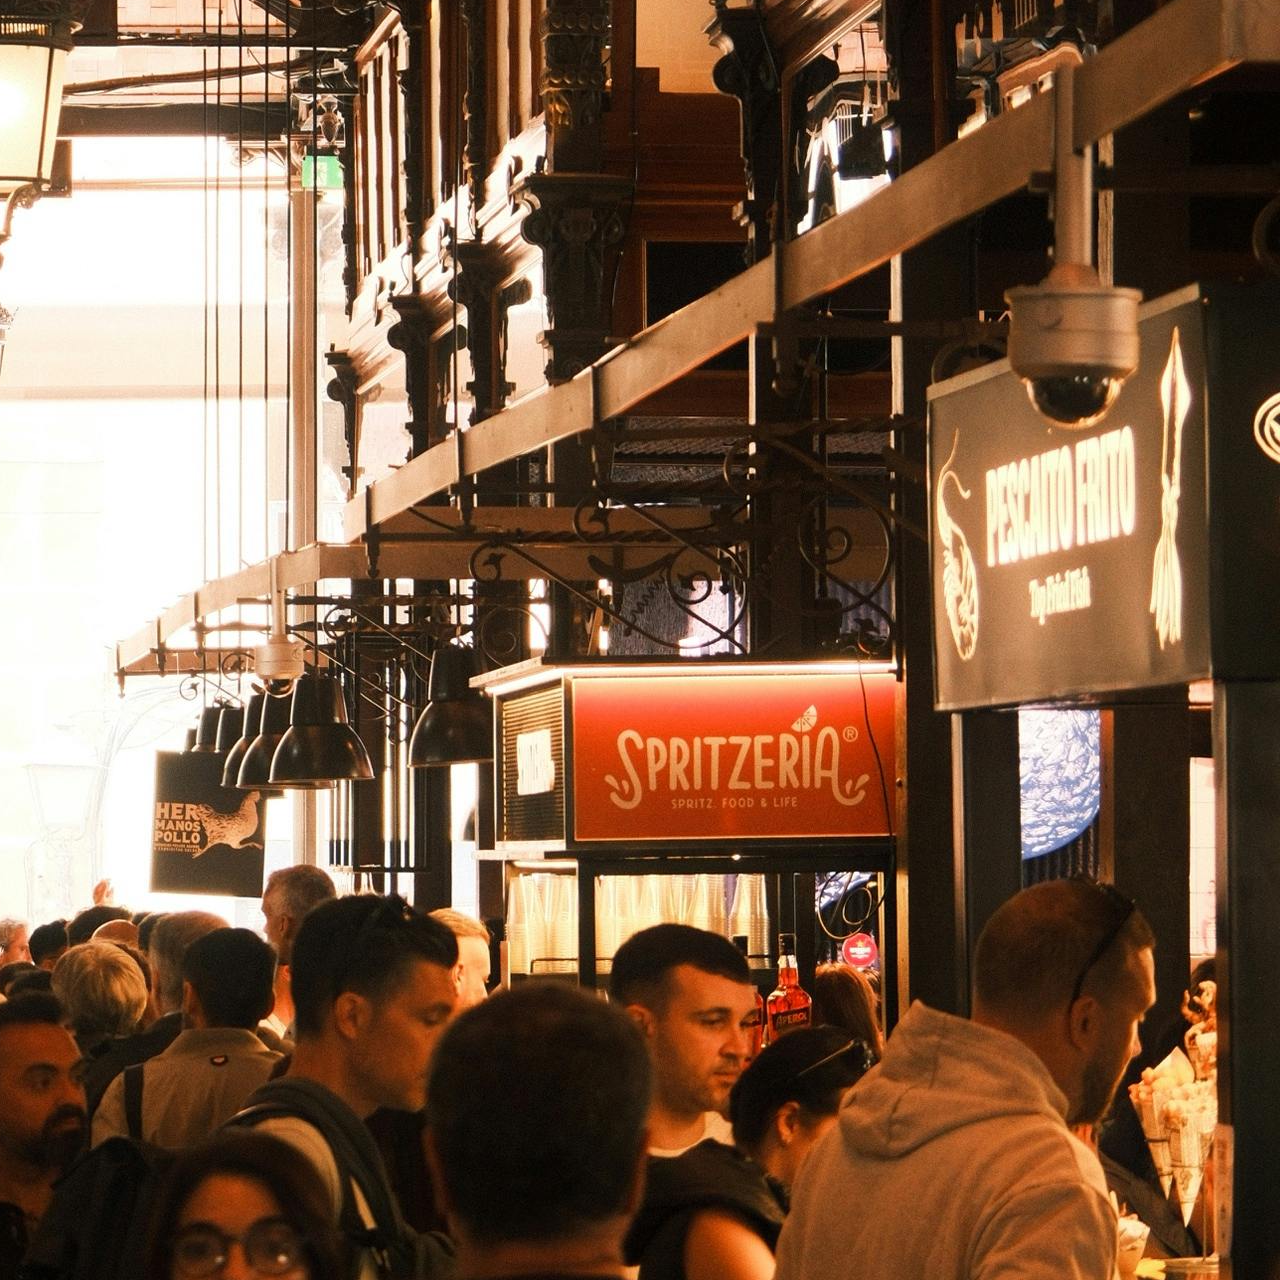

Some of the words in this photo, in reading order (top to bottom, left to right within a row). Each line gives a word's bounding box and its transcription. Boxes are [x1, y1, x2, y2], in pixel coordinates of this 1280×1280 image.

[985, 444, 1074, 568] PESCAITO
[1074, 425, 1136, 547] FRITO
[722, 796, 754, 808] FOOD
[760, 797, 767, 807] &
[773, 795, 798, 808] LIFE
[155, 801, 201, 820] HER
[154, 819, 201, 832] MANOS
[153, 830, 201, 844] POLLO
